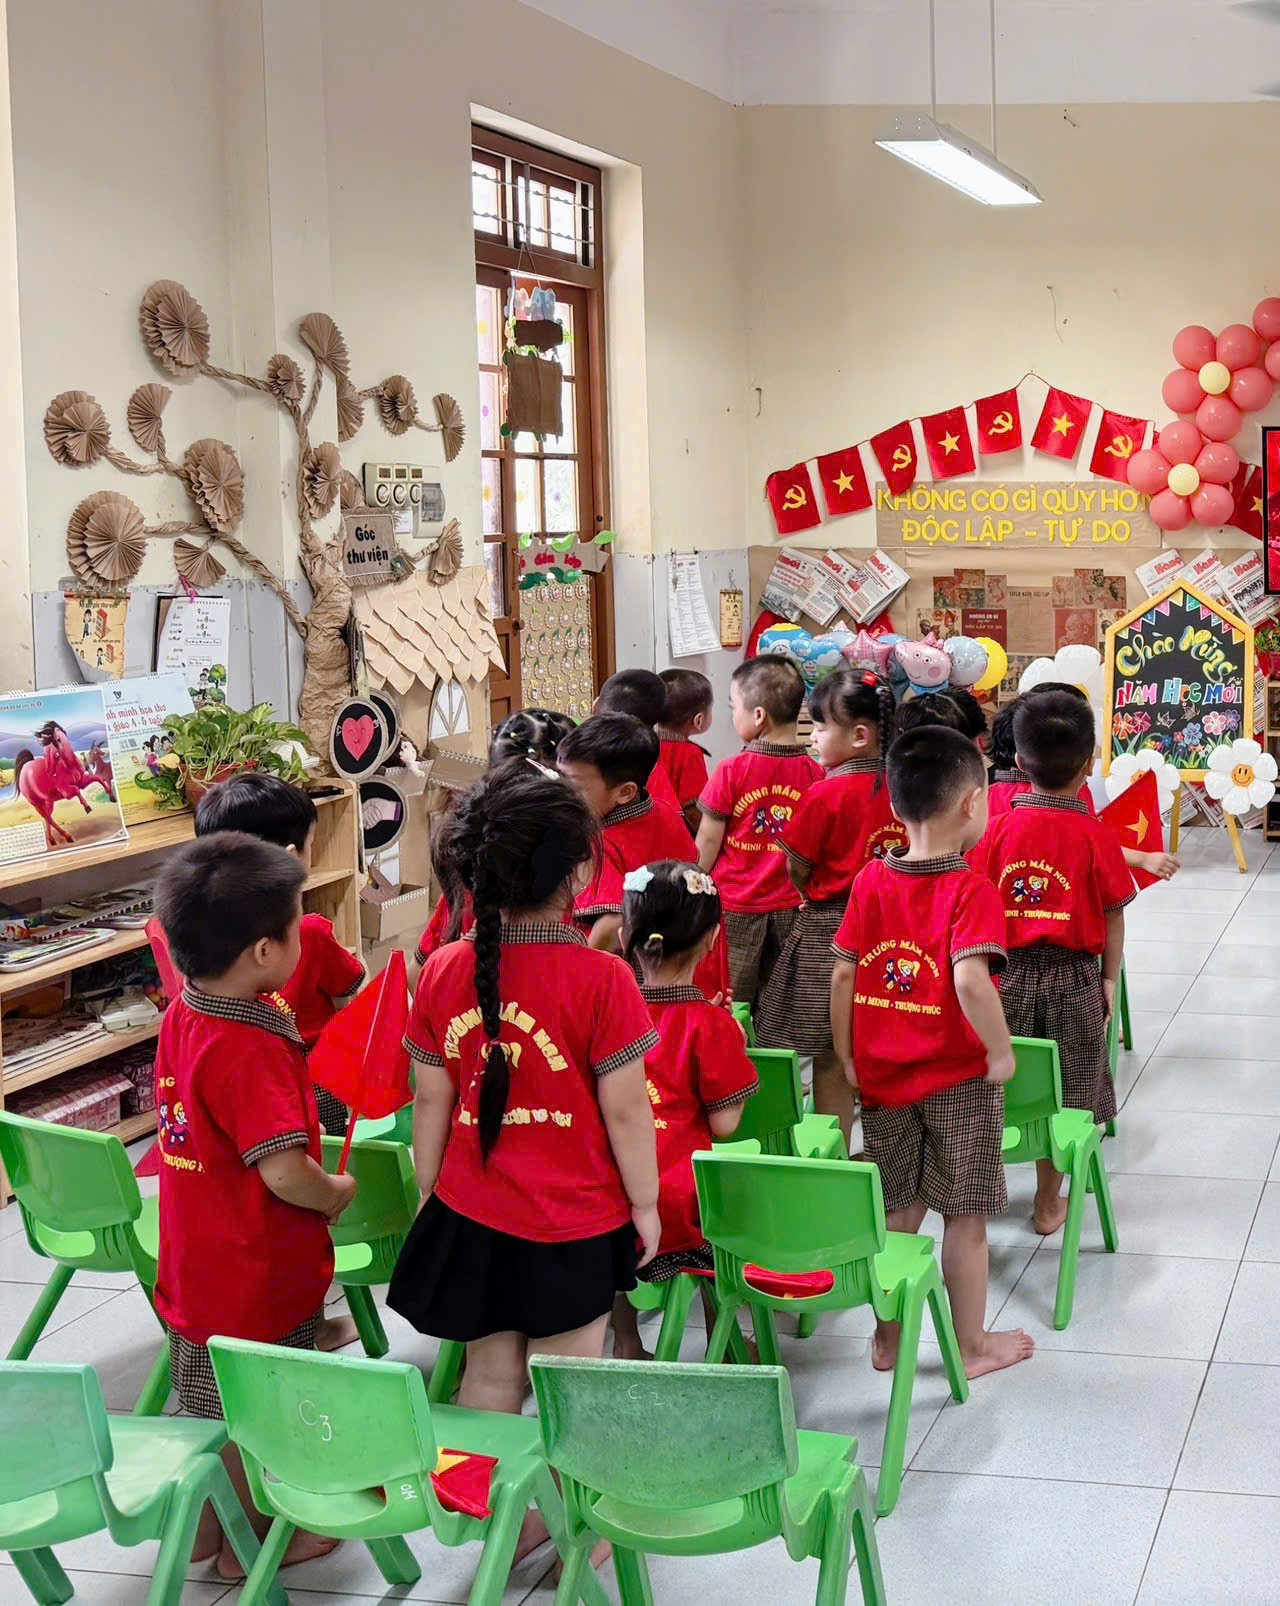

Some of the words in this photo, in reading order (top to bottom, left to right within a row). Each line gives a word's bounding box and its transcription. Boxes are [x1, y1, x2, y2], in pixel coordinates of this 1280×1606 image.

[877, 485, 966, 512] KHÔNG
[971, 484, 1009, 512] CÓ
[1012, 484, 1038, 512] GÌ
[355, 524, 376, 542] Góc
[901, 515, 960, 547] ĐỘC
[964, 515, 1014, 547] LẬP
[1043, 517, 1083, 547] TỰ
[1092, 519, 1132, 542] DO
[347, 548, 366, 565] thư
[367, 545, 389, 566] viện
[1116, 632, 1175, 677] Chào
[1179, 625, 1238, 684] Mừng
[1115, 680, 1158, 709] NĂM
[1162, 677, 1201, 707] HỌC
[1202, 678, 1243, 706] MỚI
[118, 707, 138, 719] minh
[1053, 871, 1071, 891] NON
[923, 953, 940, 978] NON
[867, 996, 890, 1008] MINH
[894, 1000, 921, 1013] THƯỢNG
[921, 1004, 941, 1015] PHÚC
